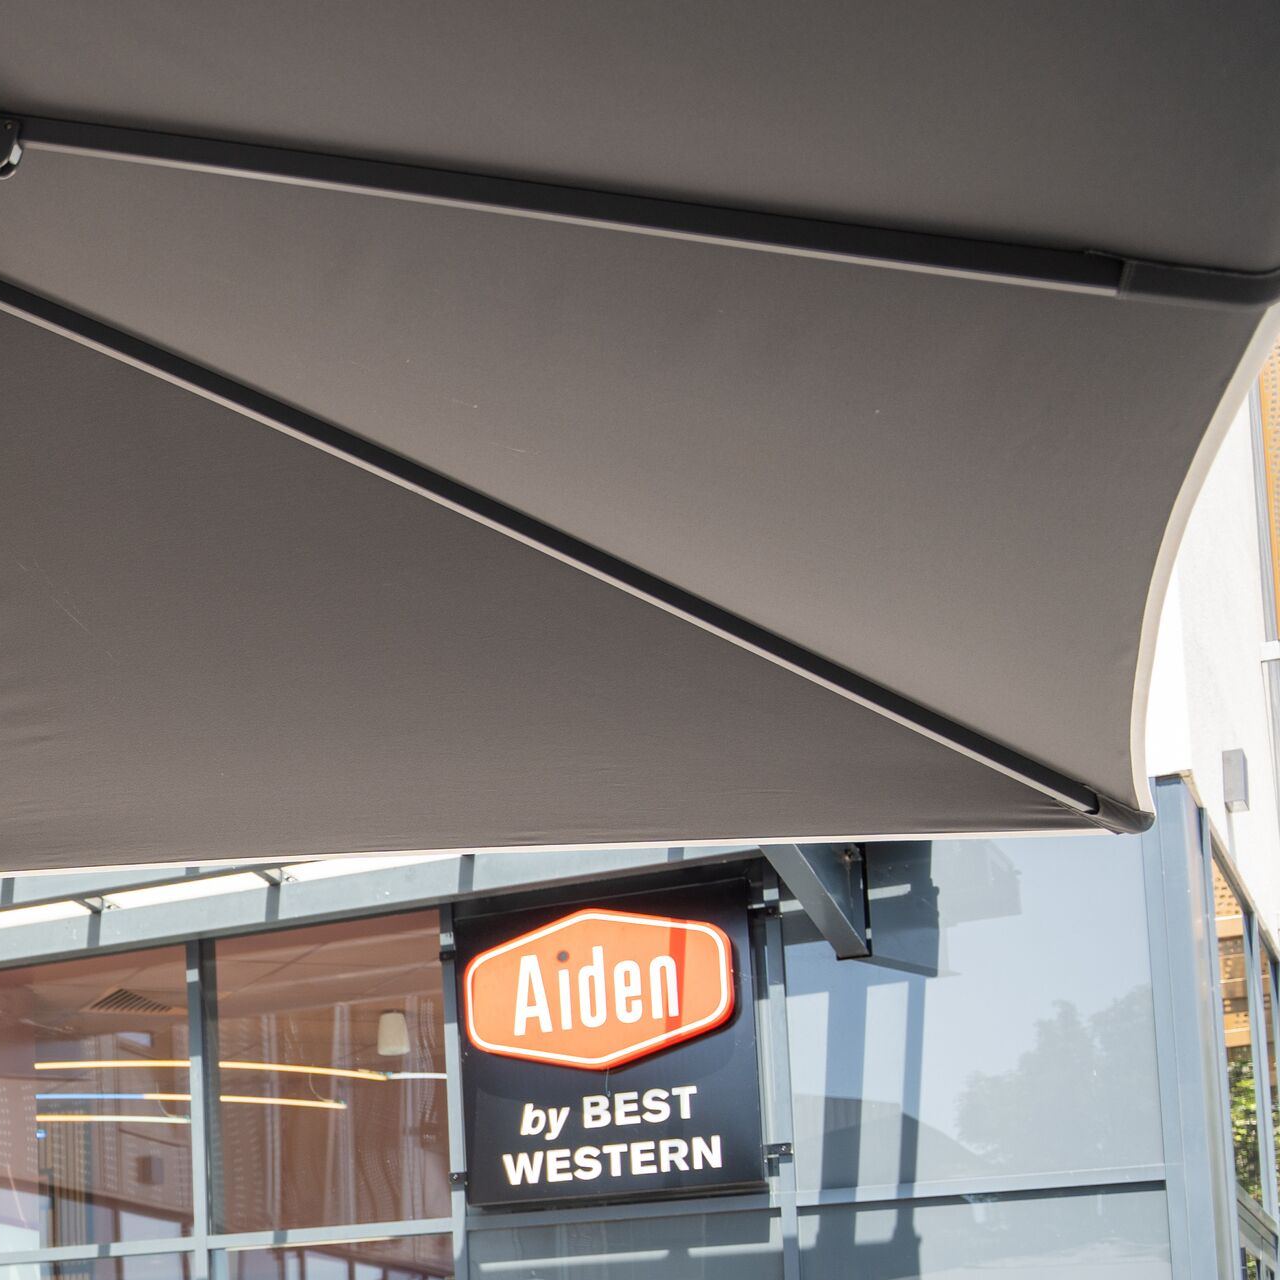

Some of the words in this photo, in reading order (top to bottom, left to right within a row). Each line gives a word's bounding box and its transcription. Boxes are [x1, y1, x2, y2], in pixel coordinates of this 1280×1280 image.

[513, 944, 680, 1037] Aiden
[519, 1102, 570, 1141] by
[582, 1085, 698, 1129] BEST
[501, 1134, 723, 1187] WESTERN
